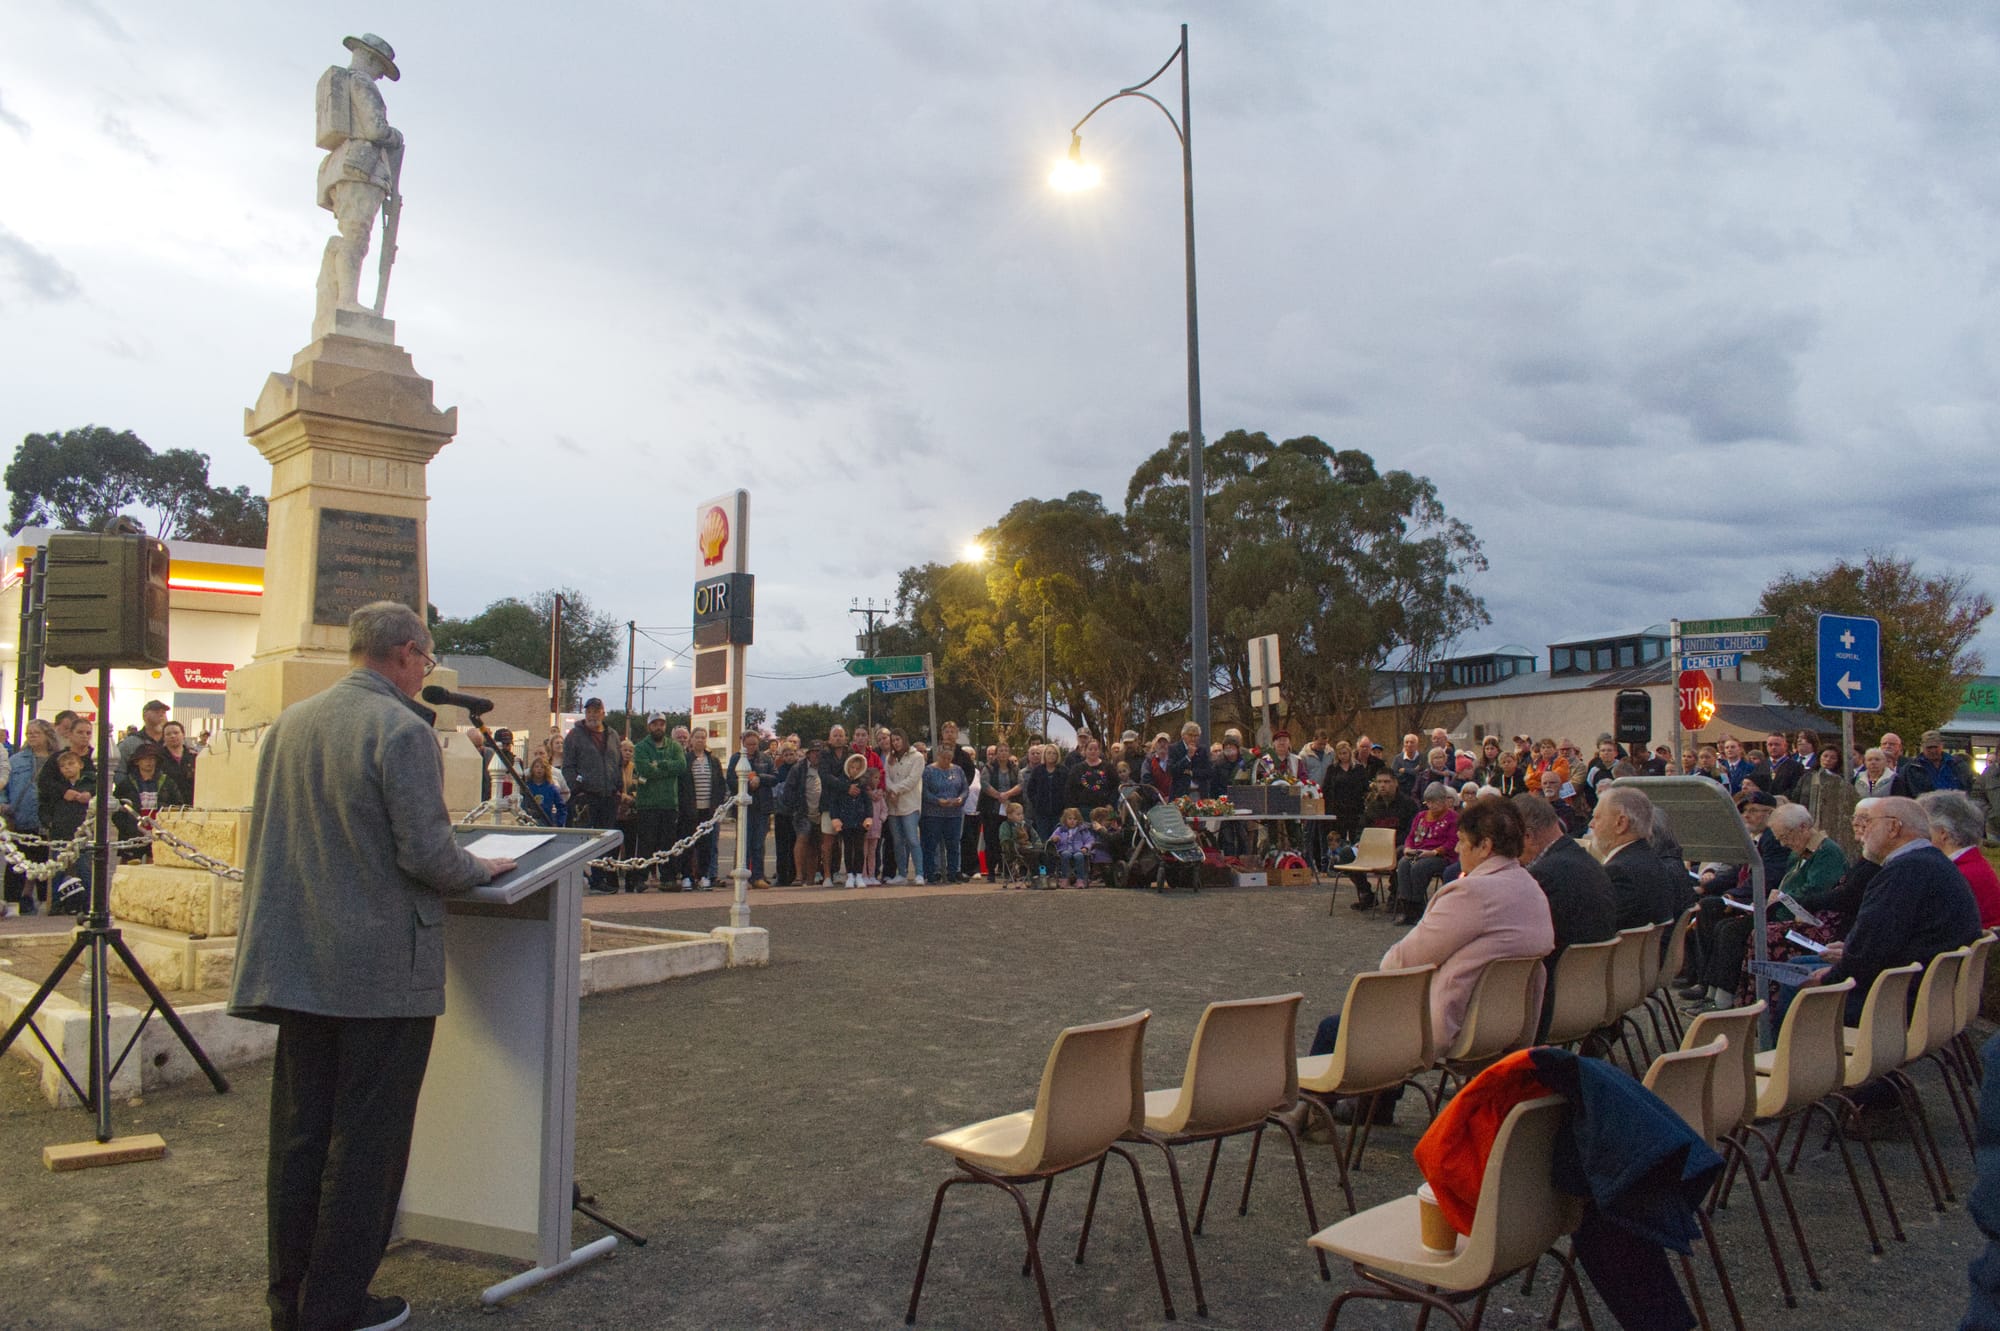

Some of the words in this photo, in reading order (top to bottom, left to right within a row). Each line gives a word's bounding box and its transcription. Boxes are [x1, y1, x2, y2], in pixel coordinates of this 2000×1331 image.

[339, 521, 353, 530] TO
[382, 543, 416, 553] SERVED
[336, 554, 376, 566] KOREAN
[379, 558, 401, 568] WAR
[336, 587, 377, 599] VIETNAM
[696, 583, 726, 615] OTR
[1684, 638, 1720, 652] UNITING
[1723, 636, 1764, 650] CHURCH
[1687, 654, 1735, 668] CEMETERY
[184, 668, 201, 676] Shell
[184, 674, 227, 684] V-Power
[1680, 686, 1711, 711] STOP
